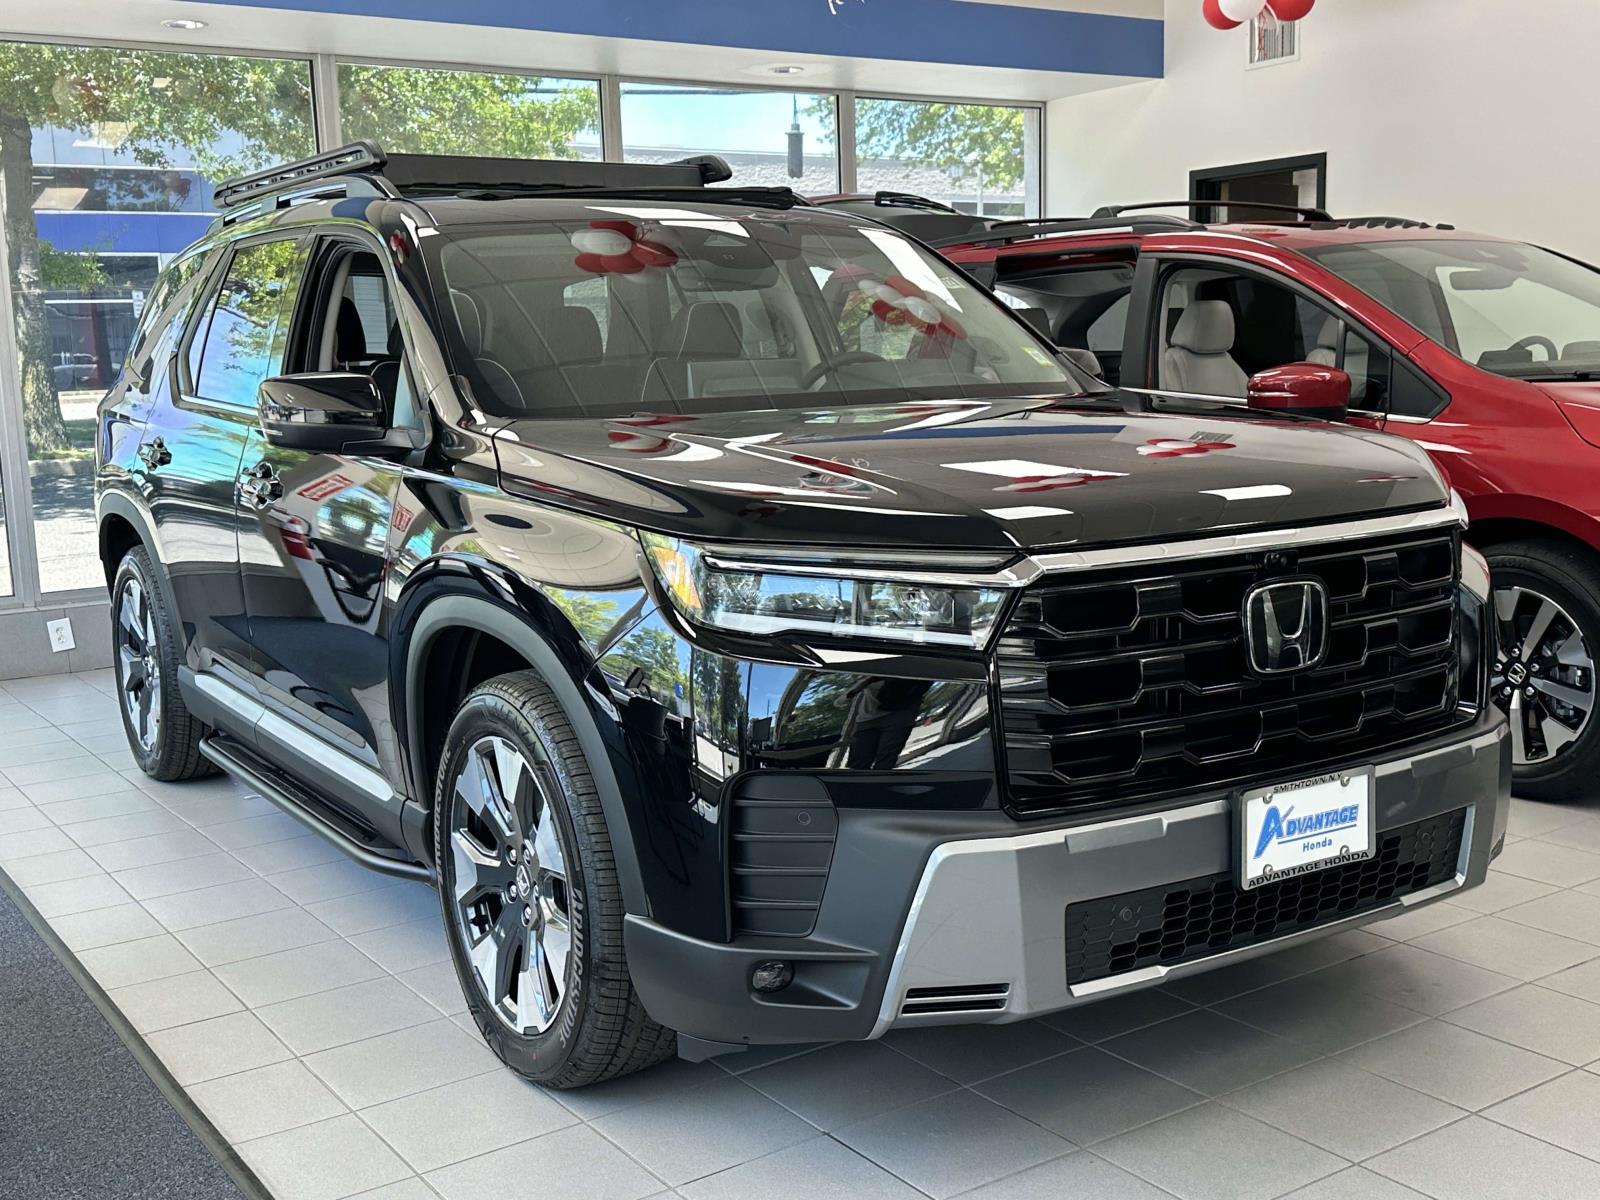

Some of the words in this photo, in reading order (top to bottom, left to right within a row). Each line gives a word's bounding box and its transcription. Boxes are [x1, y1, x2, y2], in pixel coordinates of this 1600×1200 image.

[1253, 804, 1359, 859] ADVANTAGE
[1302, 837, 1333, 852] Honda
[1248, 861, 1321, 888] ADVANTAGE
[1324, 851, 1369, 866] HONDA
